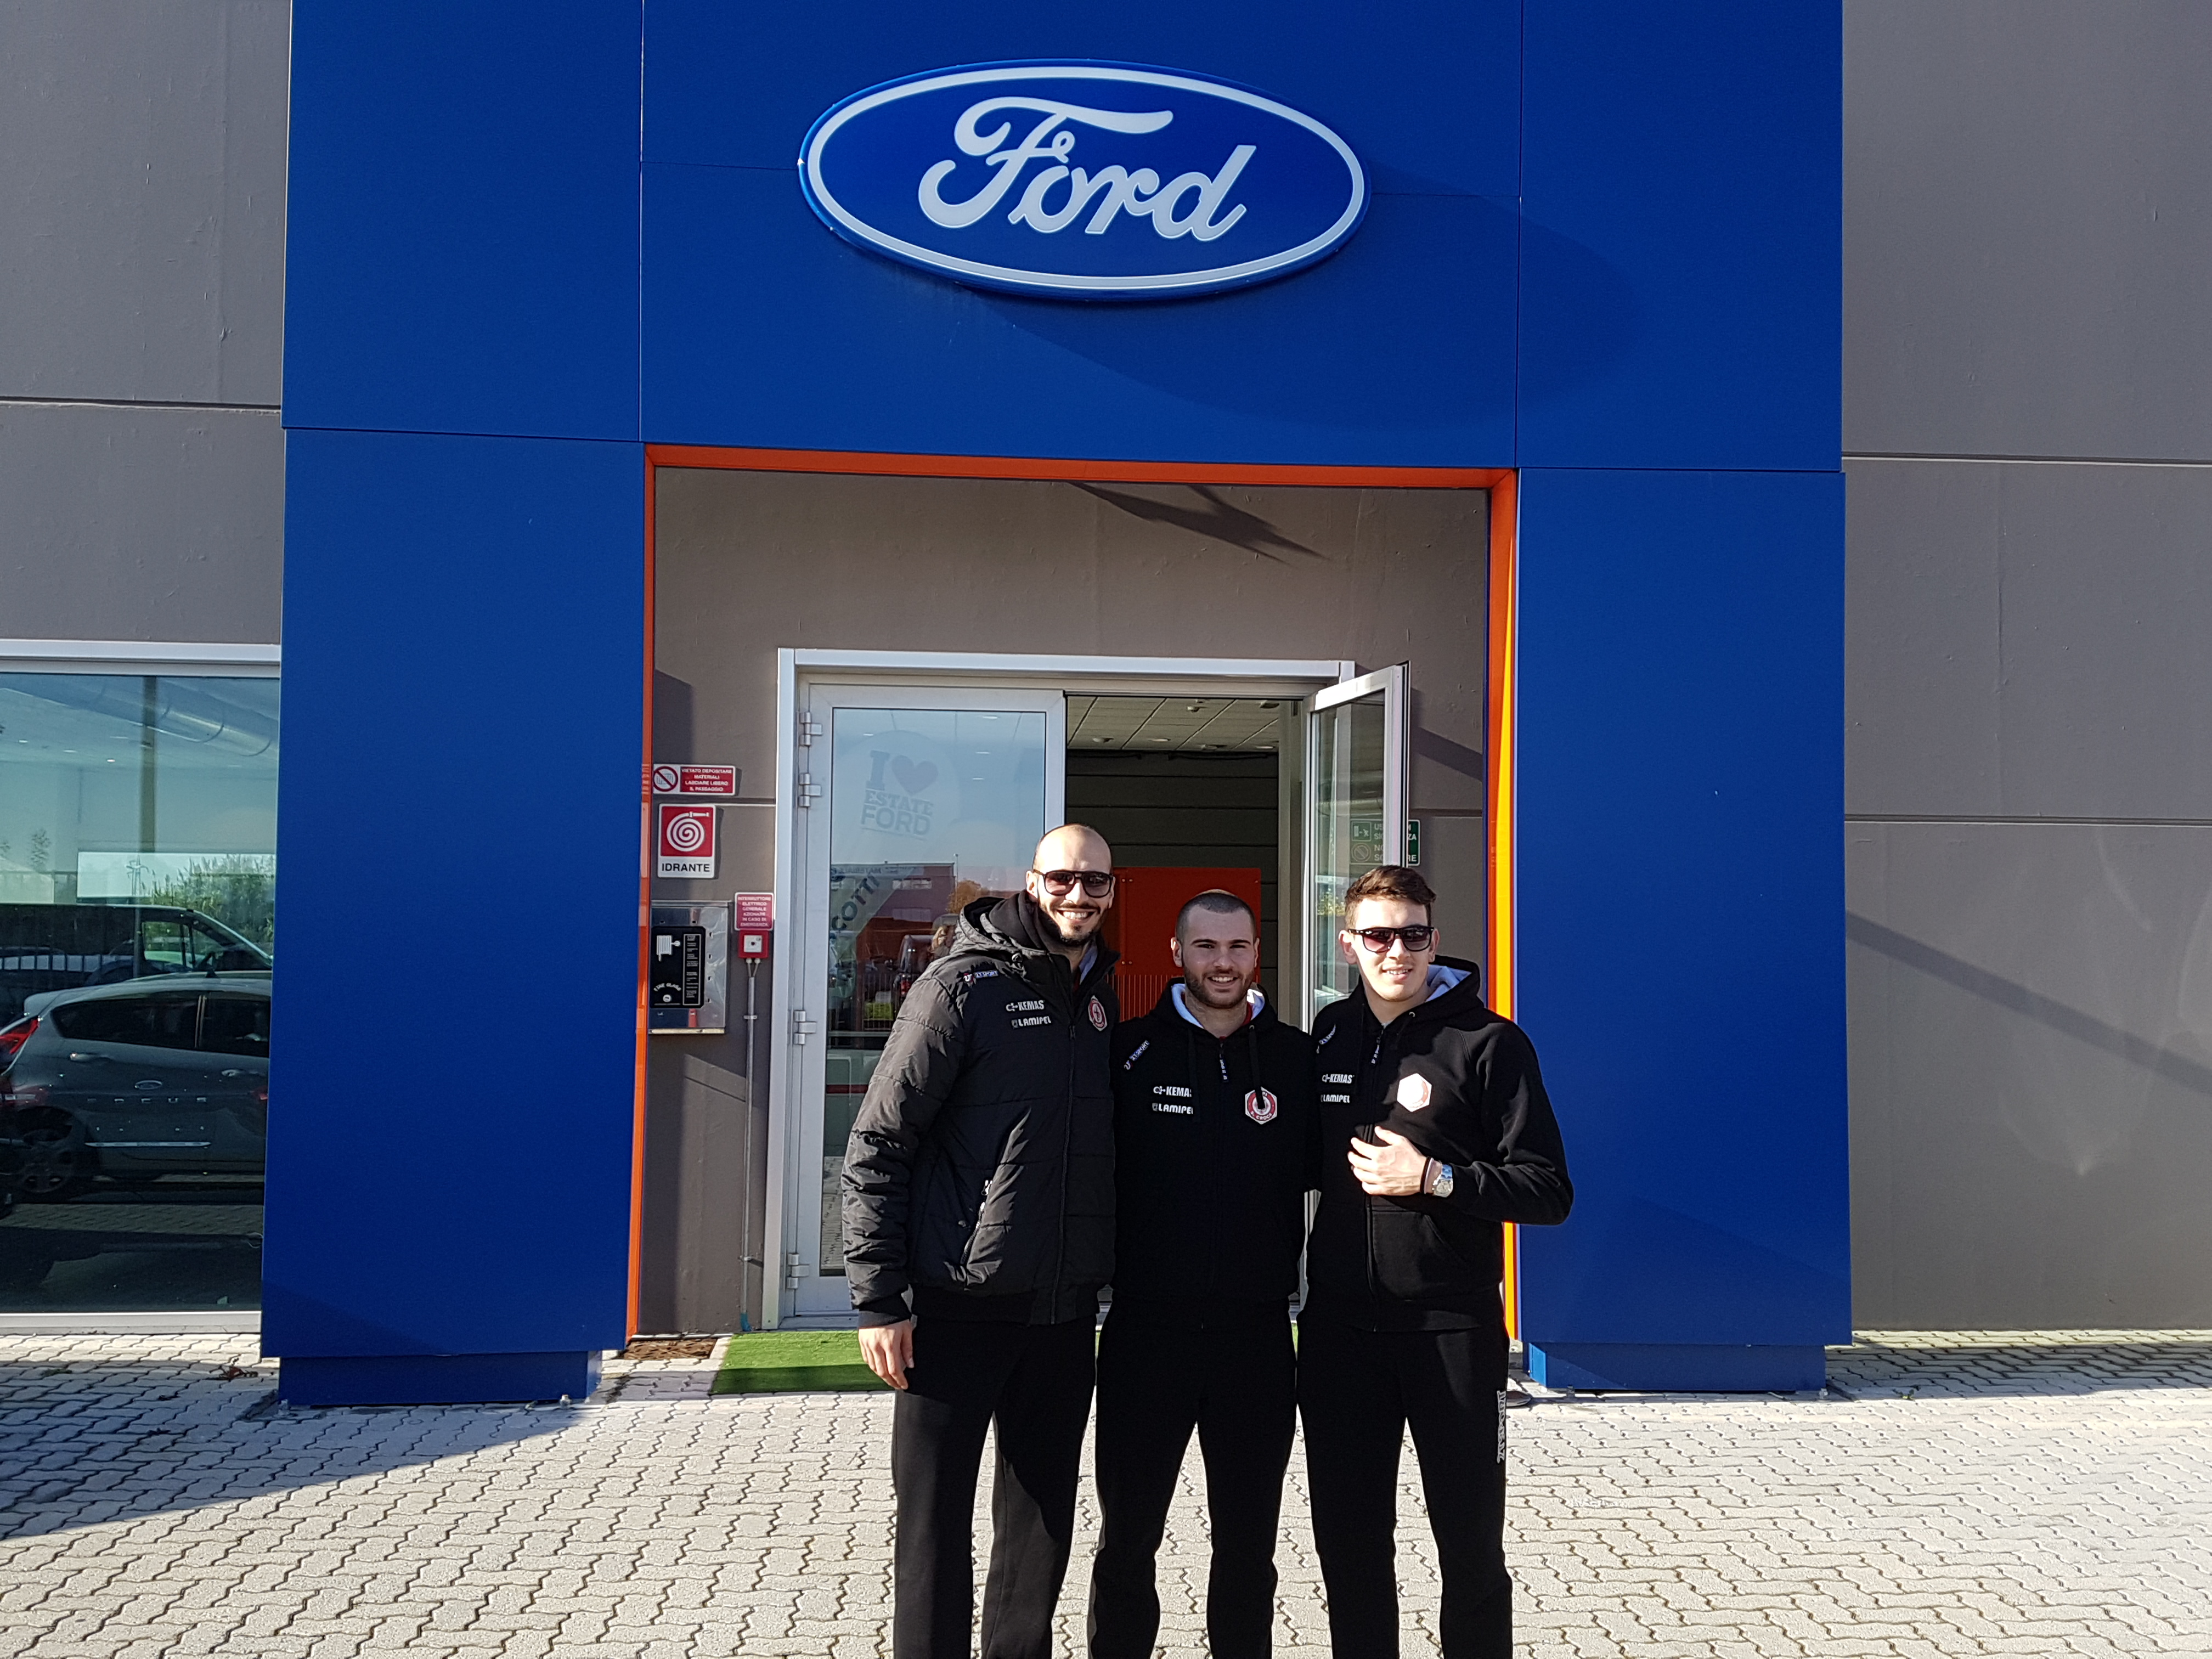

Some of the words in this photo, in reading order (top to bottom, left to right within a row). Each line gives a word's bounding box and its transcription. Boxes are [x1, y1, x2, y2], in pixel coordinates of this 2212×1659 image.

[918, 96, 1256, 241] Ford
[865, 789, 934, 816] ESTATE
[860, 804, 931, 836] FORD
[662, 863, 710, 872] IDRANTE
[1018, 1000, 1045, 1011] KEMAS
[1018, 1016, 1052, 1027] LAMIPEL
[1323, 1094, 1350, 1103] LAMIPEL
